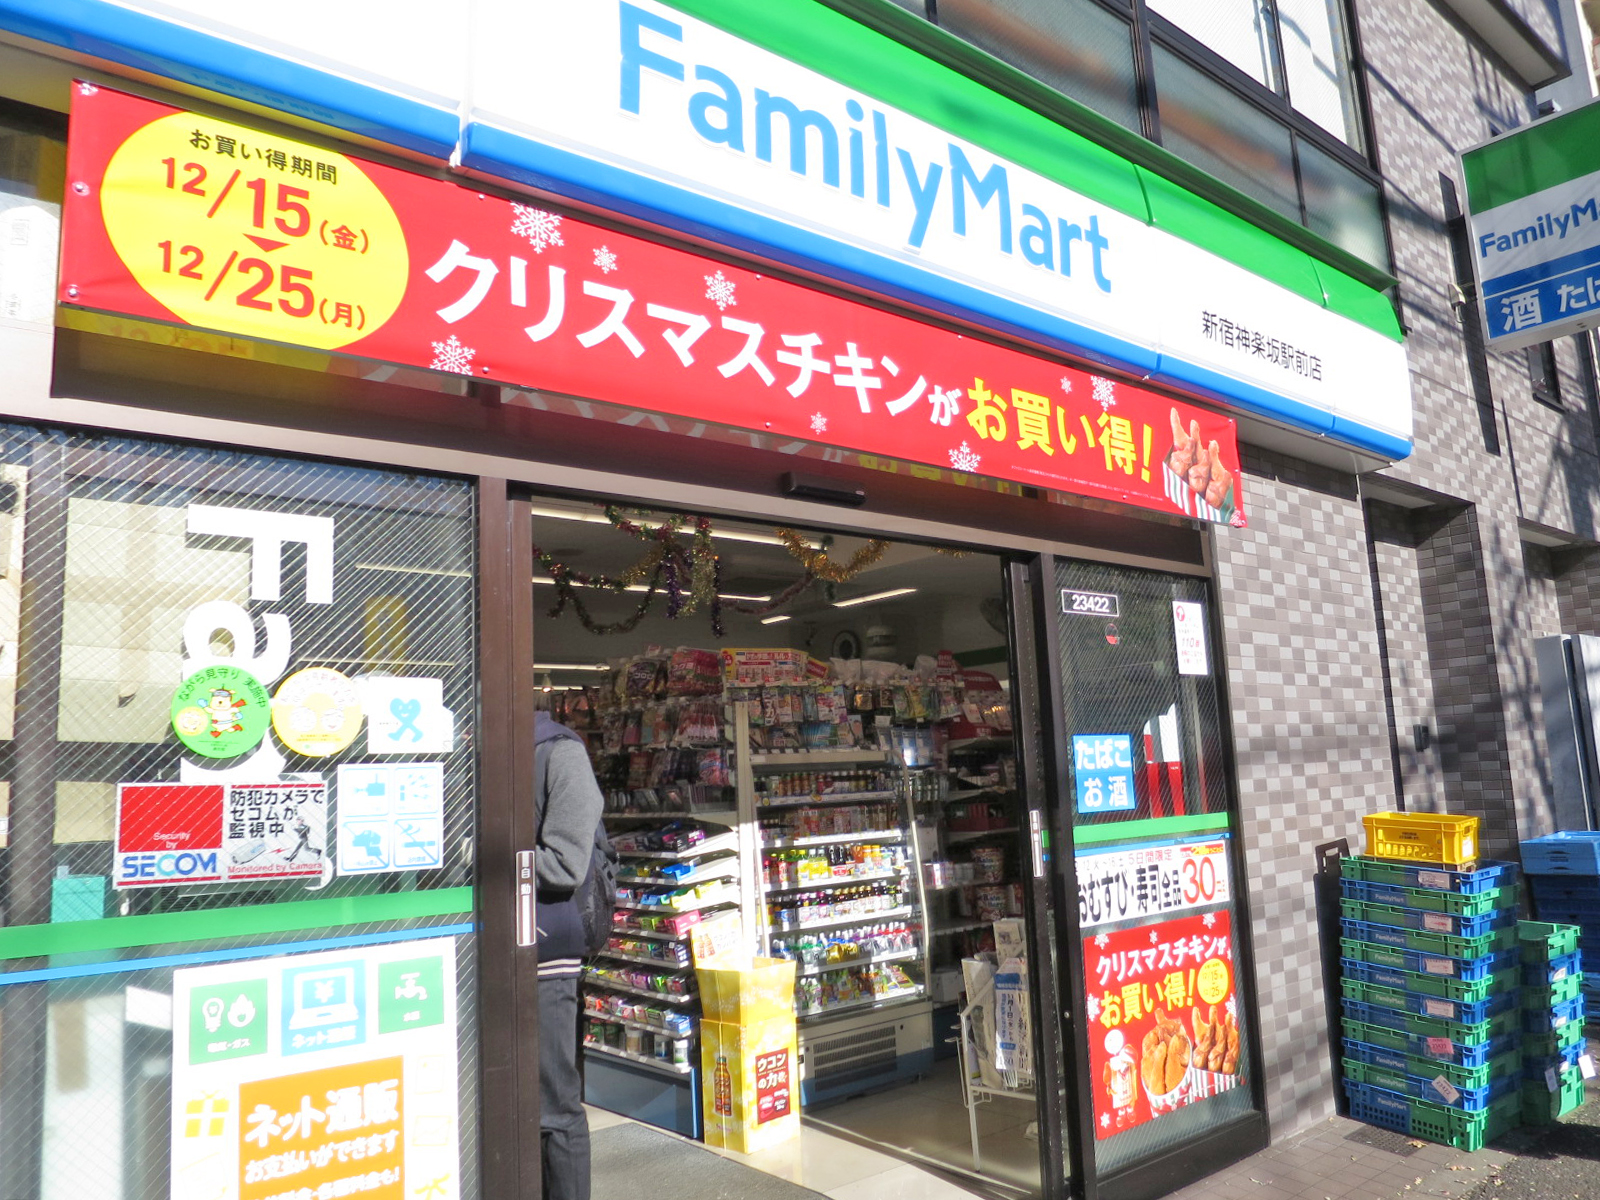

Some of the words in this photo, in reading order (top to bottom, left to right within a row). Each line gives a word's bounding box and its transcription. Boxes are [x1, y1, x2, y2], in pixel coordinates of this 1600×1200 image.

[189, 129, 338, 185] お買い得期間
[619, 0, 1112, 294] FamilyMart
[1479, 197, 1600, 259] FamilyM
[1501, 289, 1543, 332] 酒
[1202, 309, 1322, 381] 新宿神楽坂駅前店
[1071, 595, 1110, 613] 23422
[1075, 739, 1132, 770] たばこ
[230, 789, 324, 807] 防犯カメラで
[1084, 775, 1129, 807] お酒
[229, 805, 298, 823] セコムが
[153, 831, 192, 841] Security
[228, 821, 285, 840] 監視中
[165, 841, 177, 850] by
[122, 852, 217, 878] SECOM
[227, 863, 276, 874] Monitored
[276, 863, 287, 873] by
[288, 861, 323, 871] Camera
[1183, 856, 1215, 904] 30
[1095, 935, 1228, 986] クリスマスチキンが
[1375, 974, 1405, 985] FamilyMart
[1100, 968, 1196, 1029] お買い得!
[758, 1053, 787, 1073] ウコン
[1375, 1056, 1406, 1069] FamilyMart
[245, 1078, 399, 1148] ネット通販
